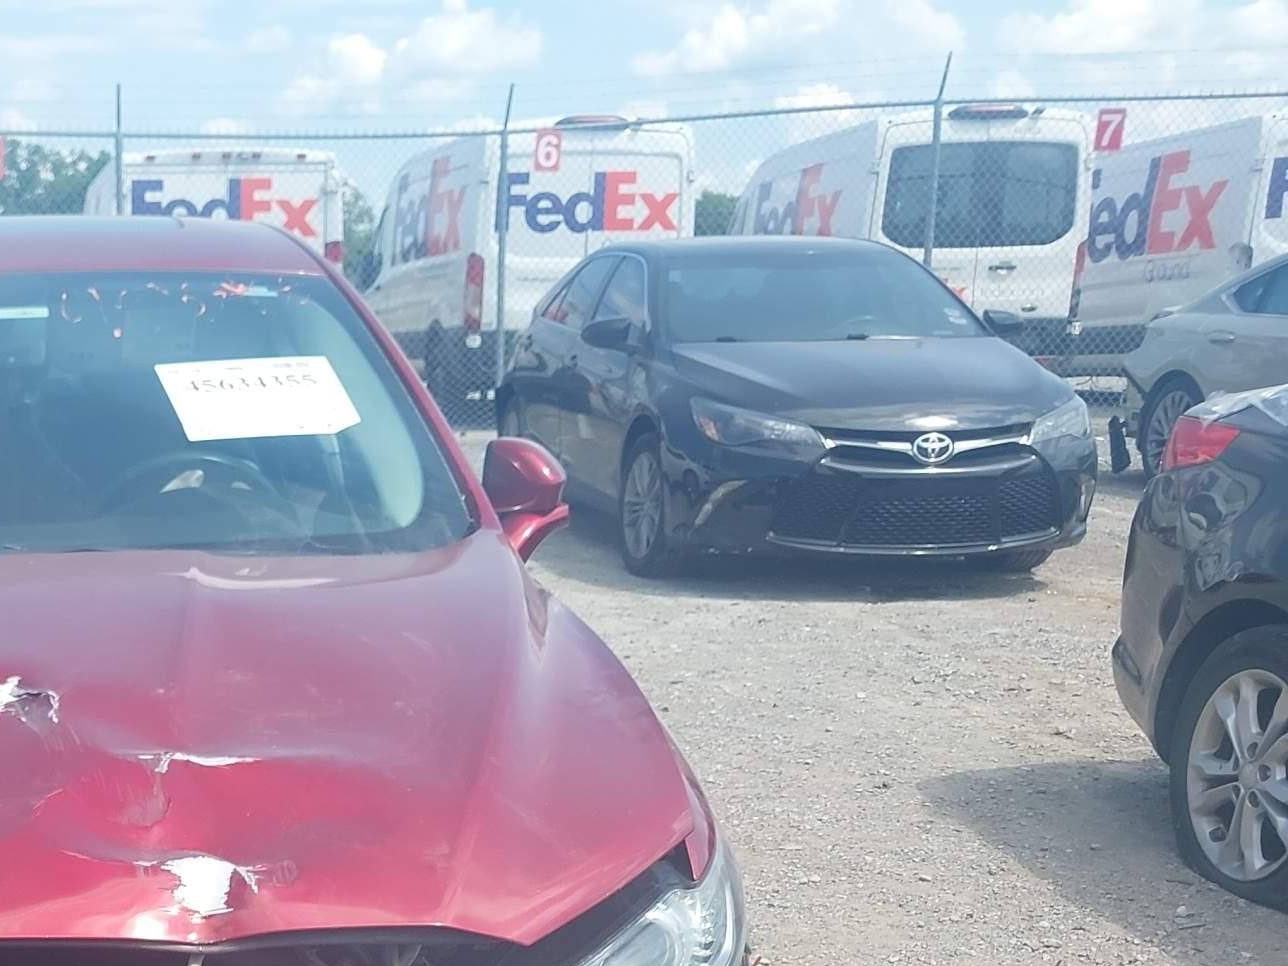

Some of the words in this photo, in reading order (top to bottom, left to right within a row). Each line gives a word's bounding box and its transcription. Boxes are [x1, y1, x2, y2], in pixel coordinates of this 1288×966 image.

[535, 134, 560, 168] 6
[1099, 113, 1123, 147] 7
[496, 171, 679, 233] FedEx
[1088, 150, 1229, 263] edEx
